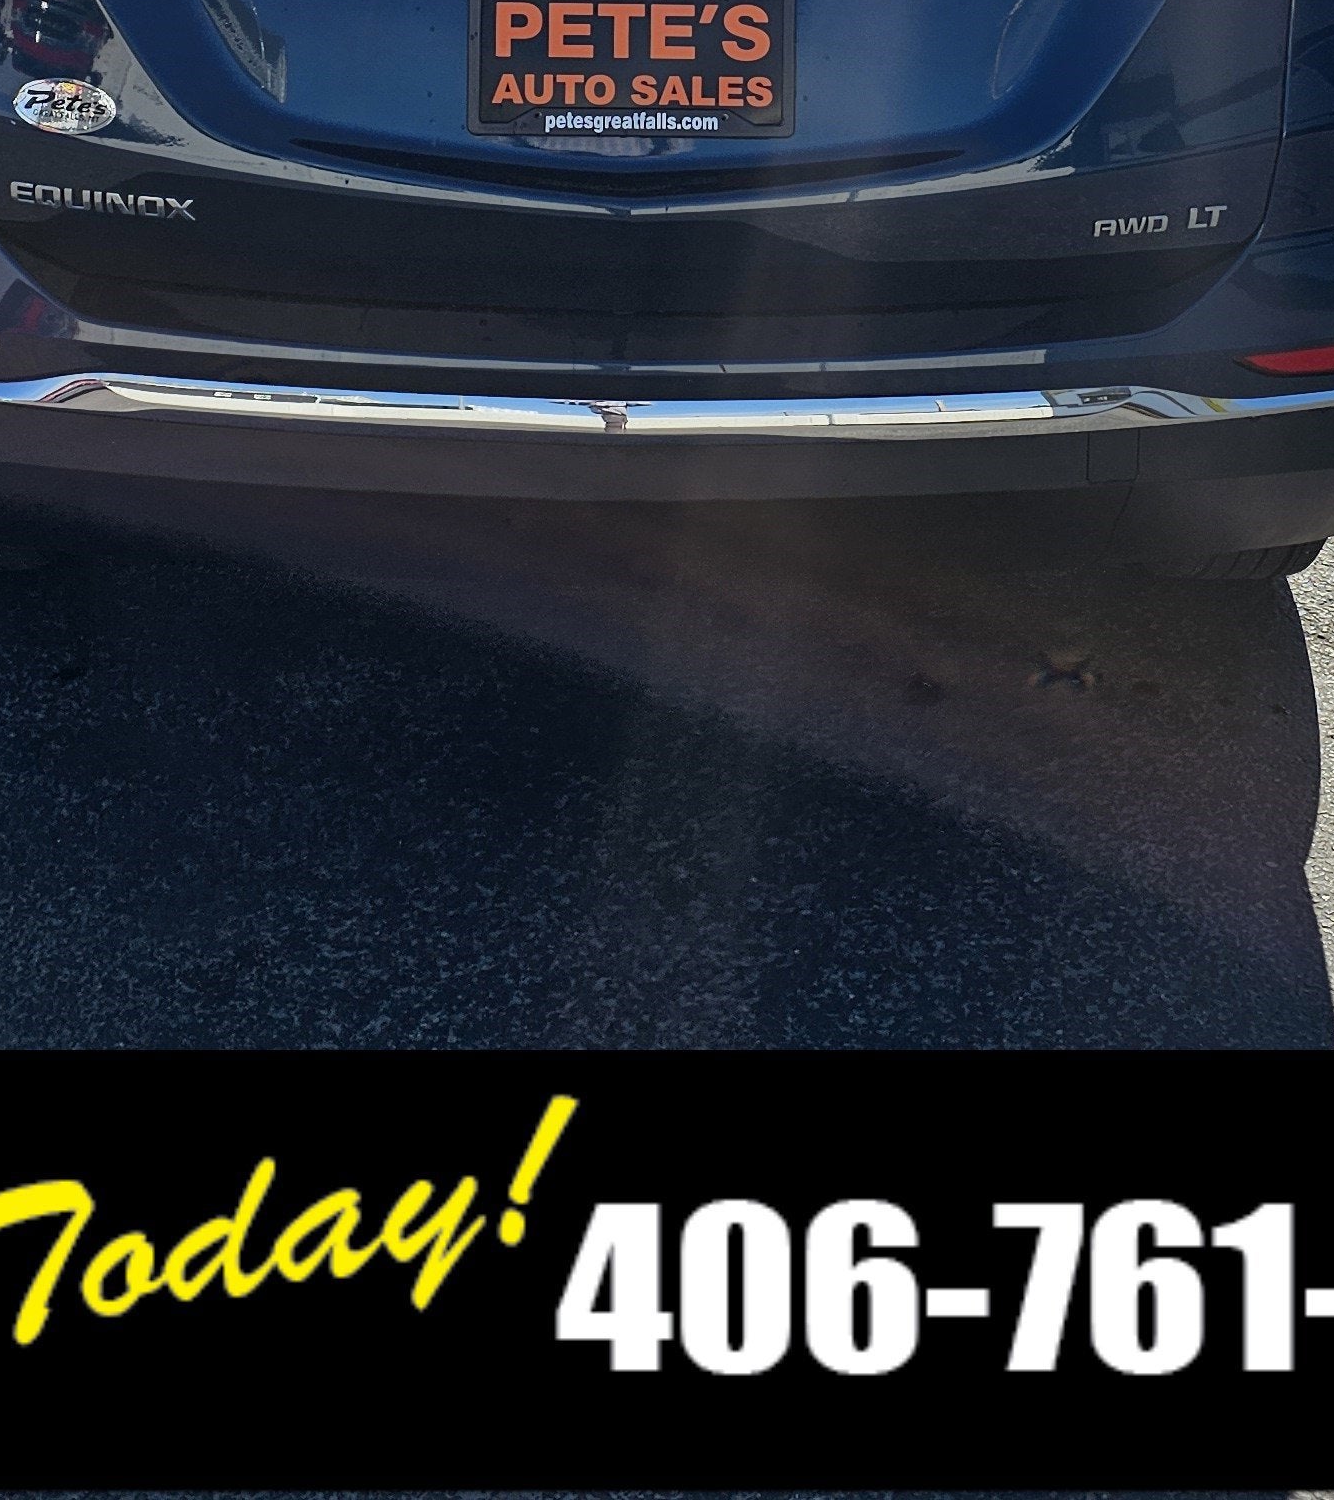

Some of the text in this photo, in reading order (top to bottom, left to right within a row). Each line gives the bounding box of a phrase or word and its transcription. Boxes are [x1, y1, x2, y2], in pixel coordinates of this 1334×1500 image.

[494, 1, 772, 62] PETE'S
[24, 89, 107, 115] Pete's
[491, 74, 774, 108] AUTO SALES
[544, 111, 719, 133] petesgreatfalls.com
[9, 180, 197, 221] EQUINOX
[1093, 205, 1228, 238] AWD LT
